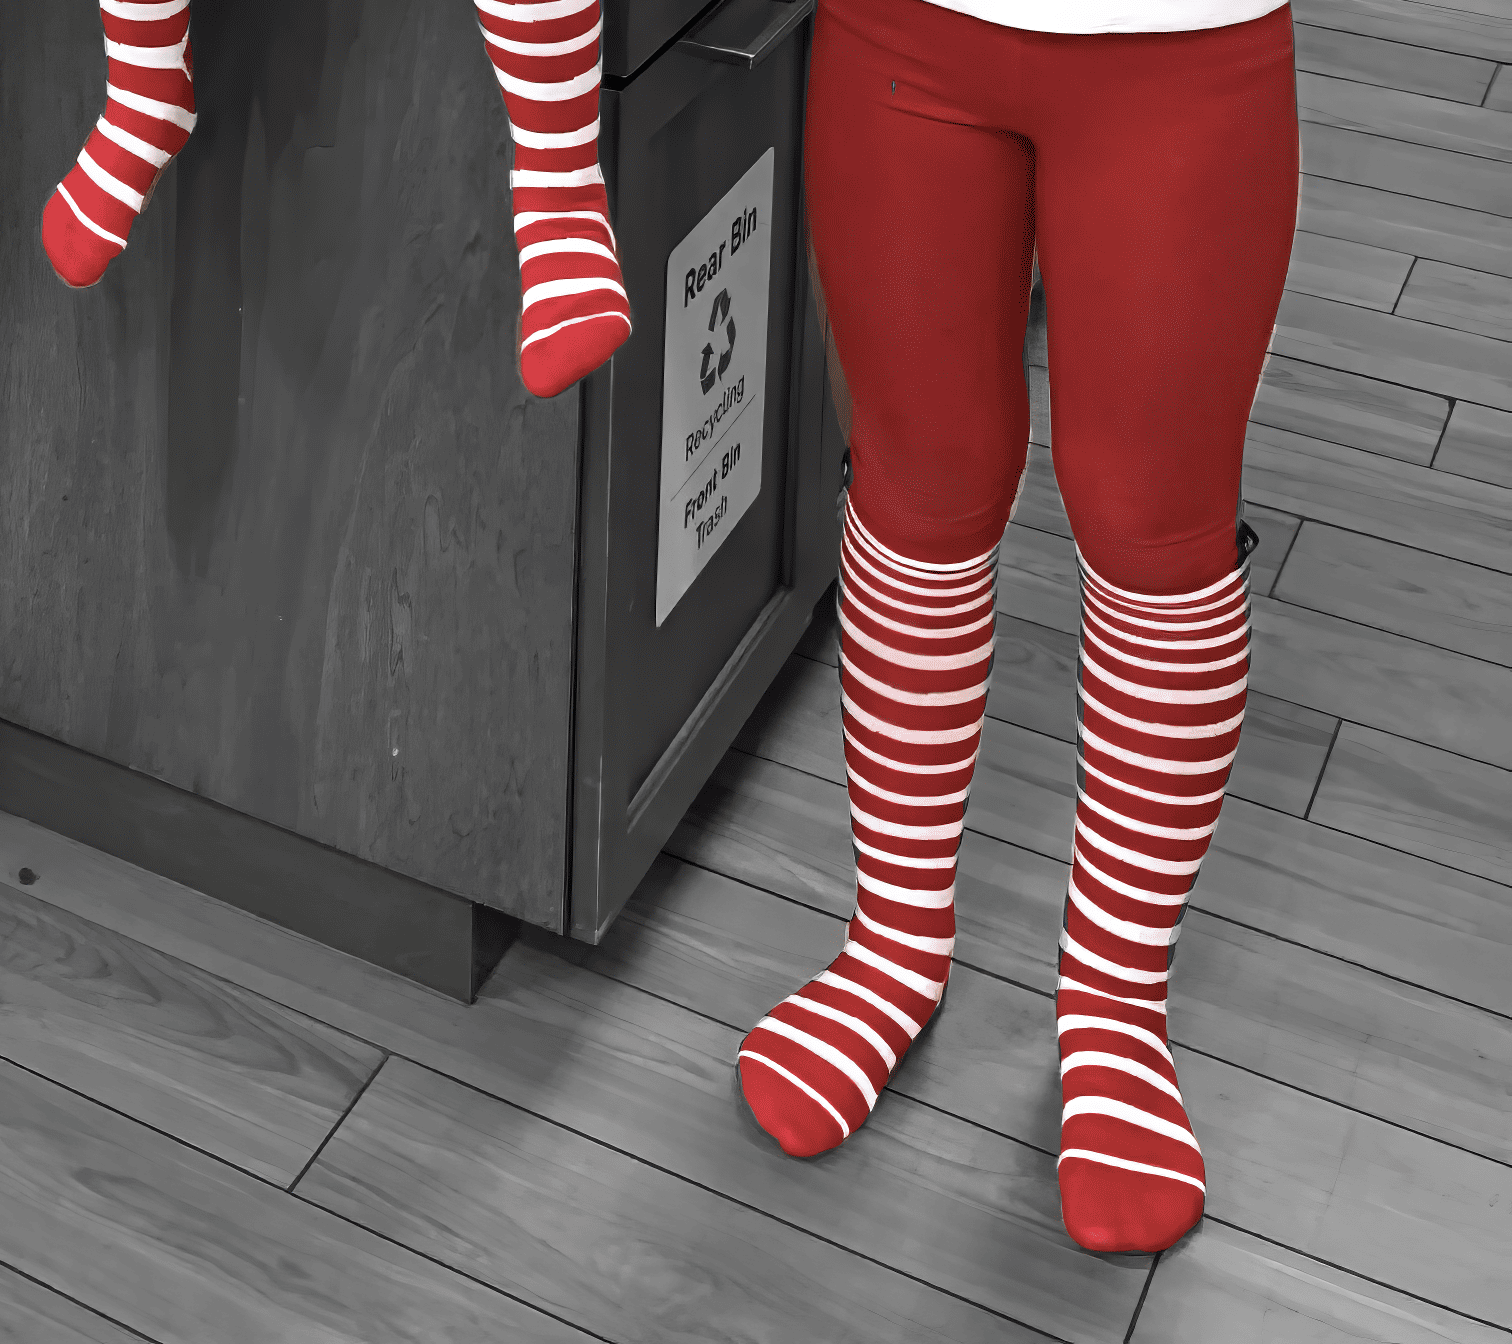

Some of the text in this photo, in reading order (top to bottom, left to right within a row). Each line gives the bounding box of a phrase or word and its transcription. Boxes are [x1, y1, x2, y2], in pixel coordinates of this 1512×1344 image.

[684, 205, 757, 308] Rear Bin
[685, 374, 745, 462] Recycling
[684, 442, 741, 529] Front Bin
[695, 495, 728, 550] Trash
